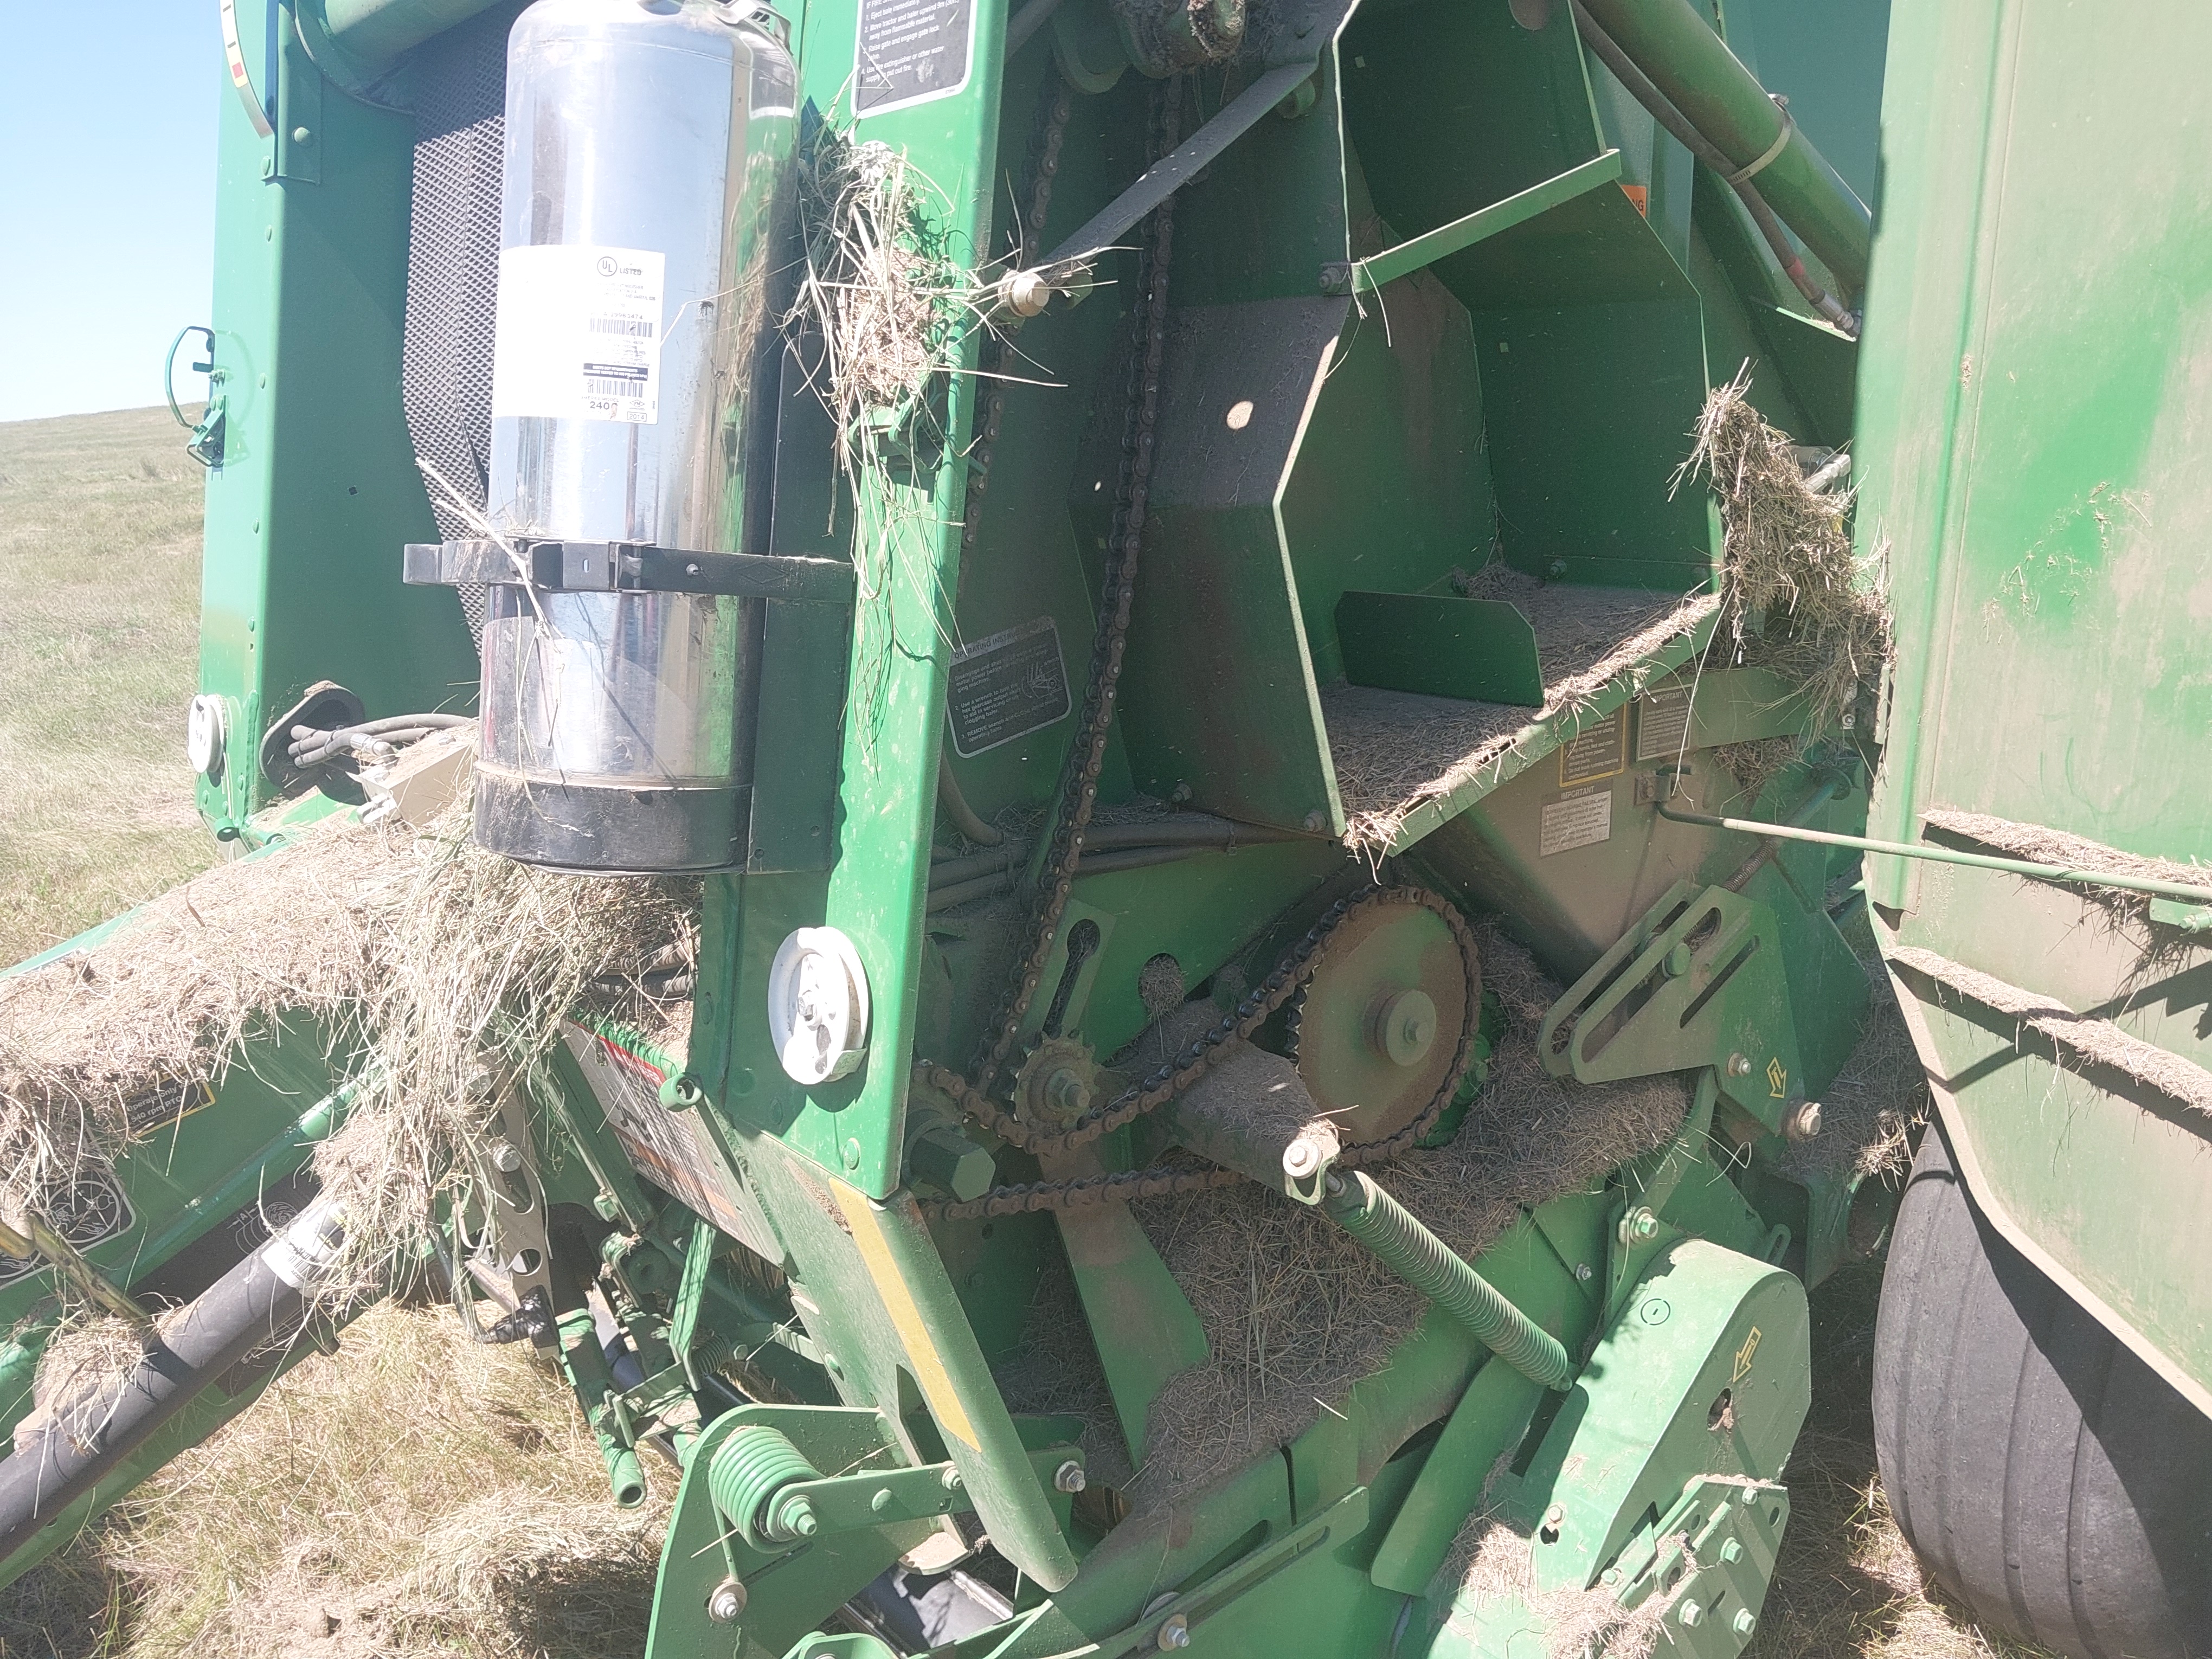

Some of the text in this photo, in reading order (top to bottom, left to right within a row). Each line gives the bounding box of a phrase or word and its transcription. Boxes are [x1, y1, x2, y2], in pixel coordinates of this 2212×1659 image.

[870, 9, 882, 21] Eject
[870, 23, 882, 31] Move
[882, 17, 897, 27] tractor
[907, 11, 918, 19] baler
[919, 4, 936, 15] upwind
[869, 32, 880, 41] away
[881, 29, 891, 37] from
[892, 21, 915, 33] flammable
[869, 43, 880, 52] Raise
[881, 40, 891, 50] gate
[901, 32, 917, 43] engage
[918, 28, 928, 38] gate
[929, 24, 940, 33] lock
[884, 55, 911, 68] extinguisher
[918, 48, 930, 58] other
[931, 46, 944, 54] water
[866, 73, 880, 83] supply
[954, 640, 991, 659] OPERATING
[970, 671, 986, 682] power
[957, 684, 968, 694] ging
[961, 700, 970, 709] Use
[975, 691, 993, 703] wrench
[962, 705, 971, 715] hex
[971, 697, 993, 711] gearcase
[993, 691, 1008, 703] output
[983, 699, 1005, 712] servicing
[964, 708, 998, 726] clogging baler.
[967, 724, 987, 737] REMOVE
[988, 717, 1004, 729] wrench
[1561, 786, 1594, 800] IMPORTANT
[159, 1088, 177, 1097] only
[131, 1095, 182, 1122] 540 rpm PTO
[239, 1212, 248, 1220] A
